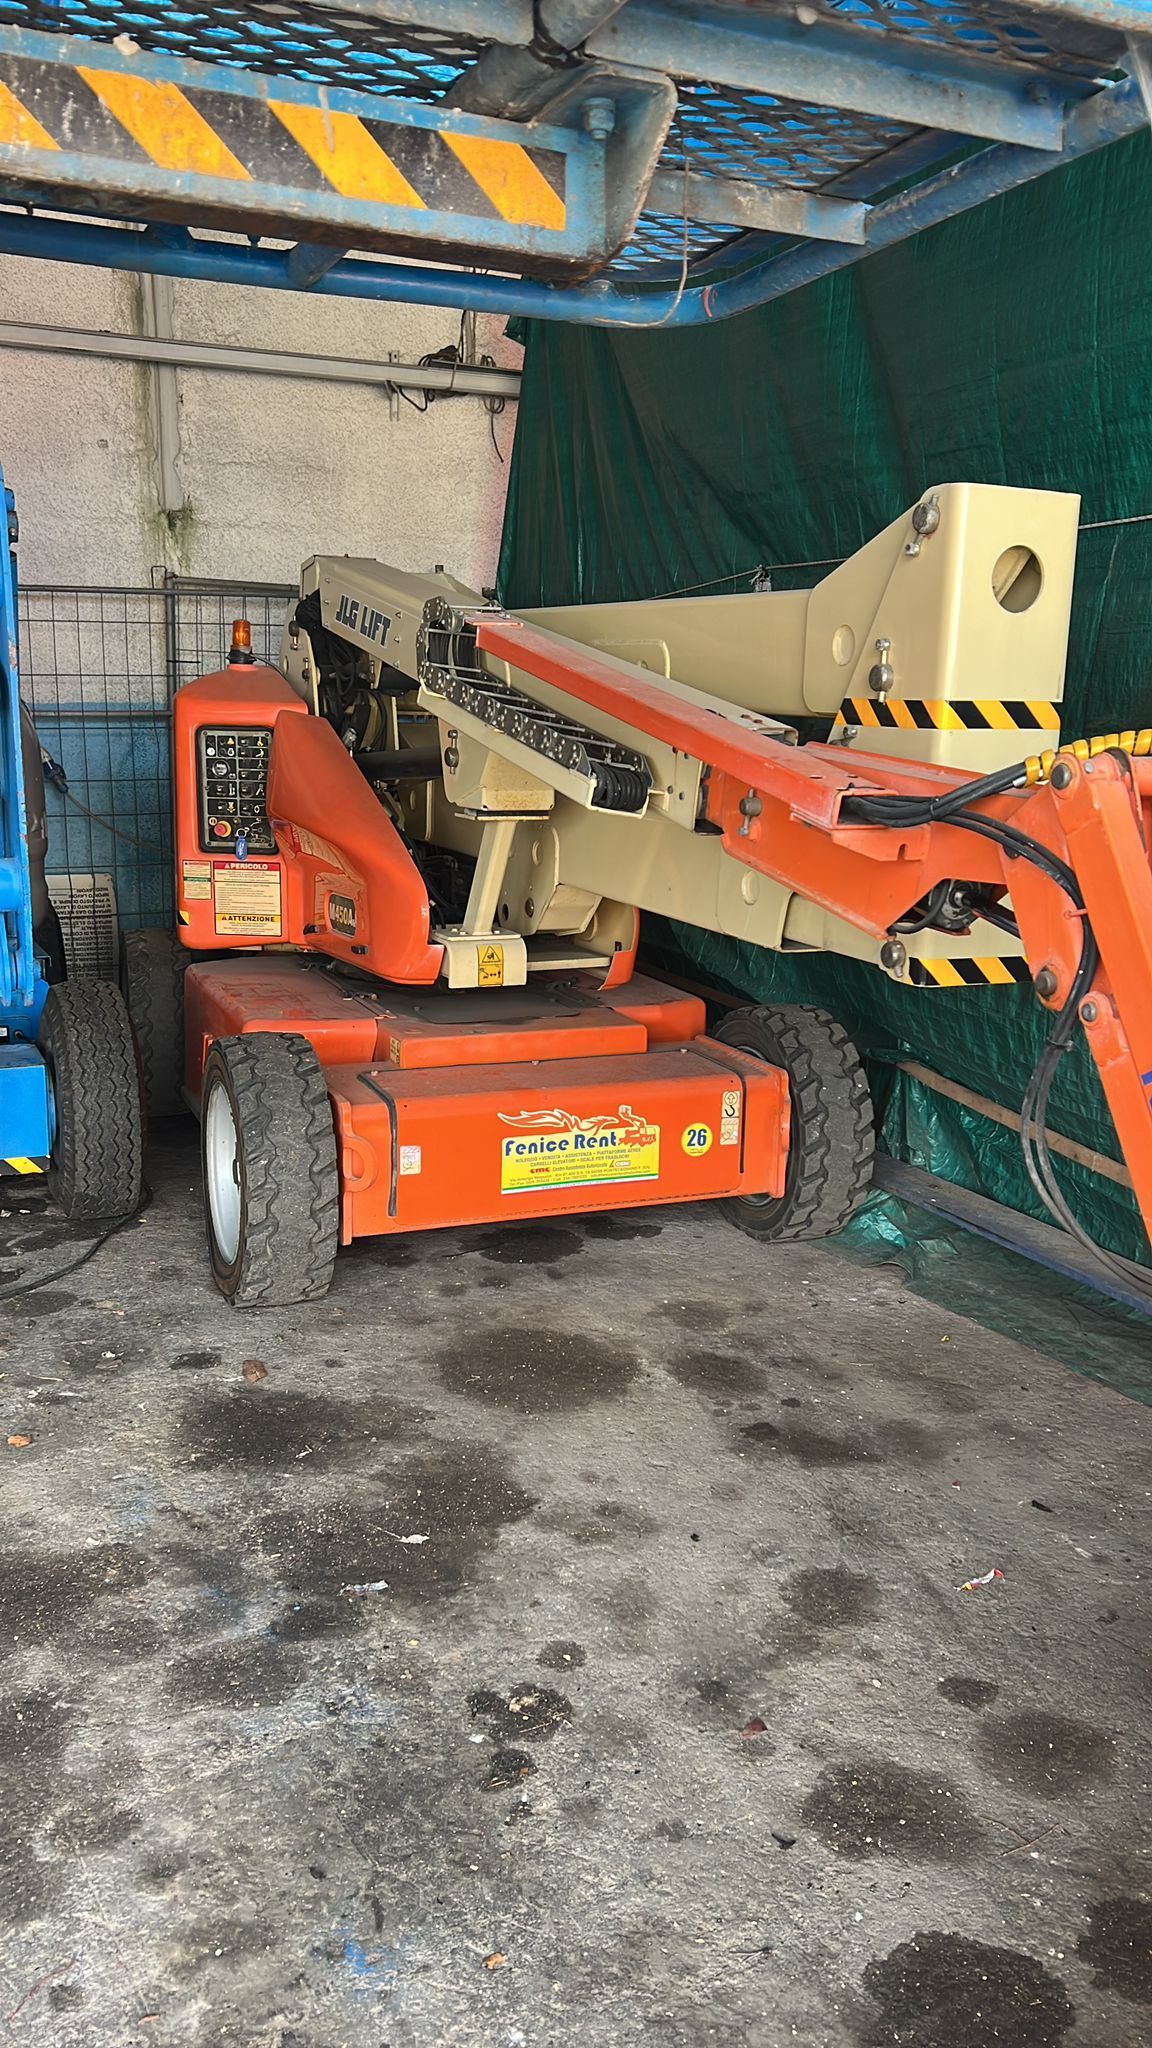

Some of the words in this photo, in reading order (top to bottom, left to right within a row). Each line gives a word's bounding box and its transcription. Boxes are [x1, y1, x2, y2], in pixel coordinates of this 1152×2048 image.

[335, 594, 360, 630] JLG
[360, 604, 391, 647] LIFT
[505, 1137, 569, 1156] Fenice
[574, 1131, 616, 1149] Rent
[687, 1129, 707, 1146] 26
